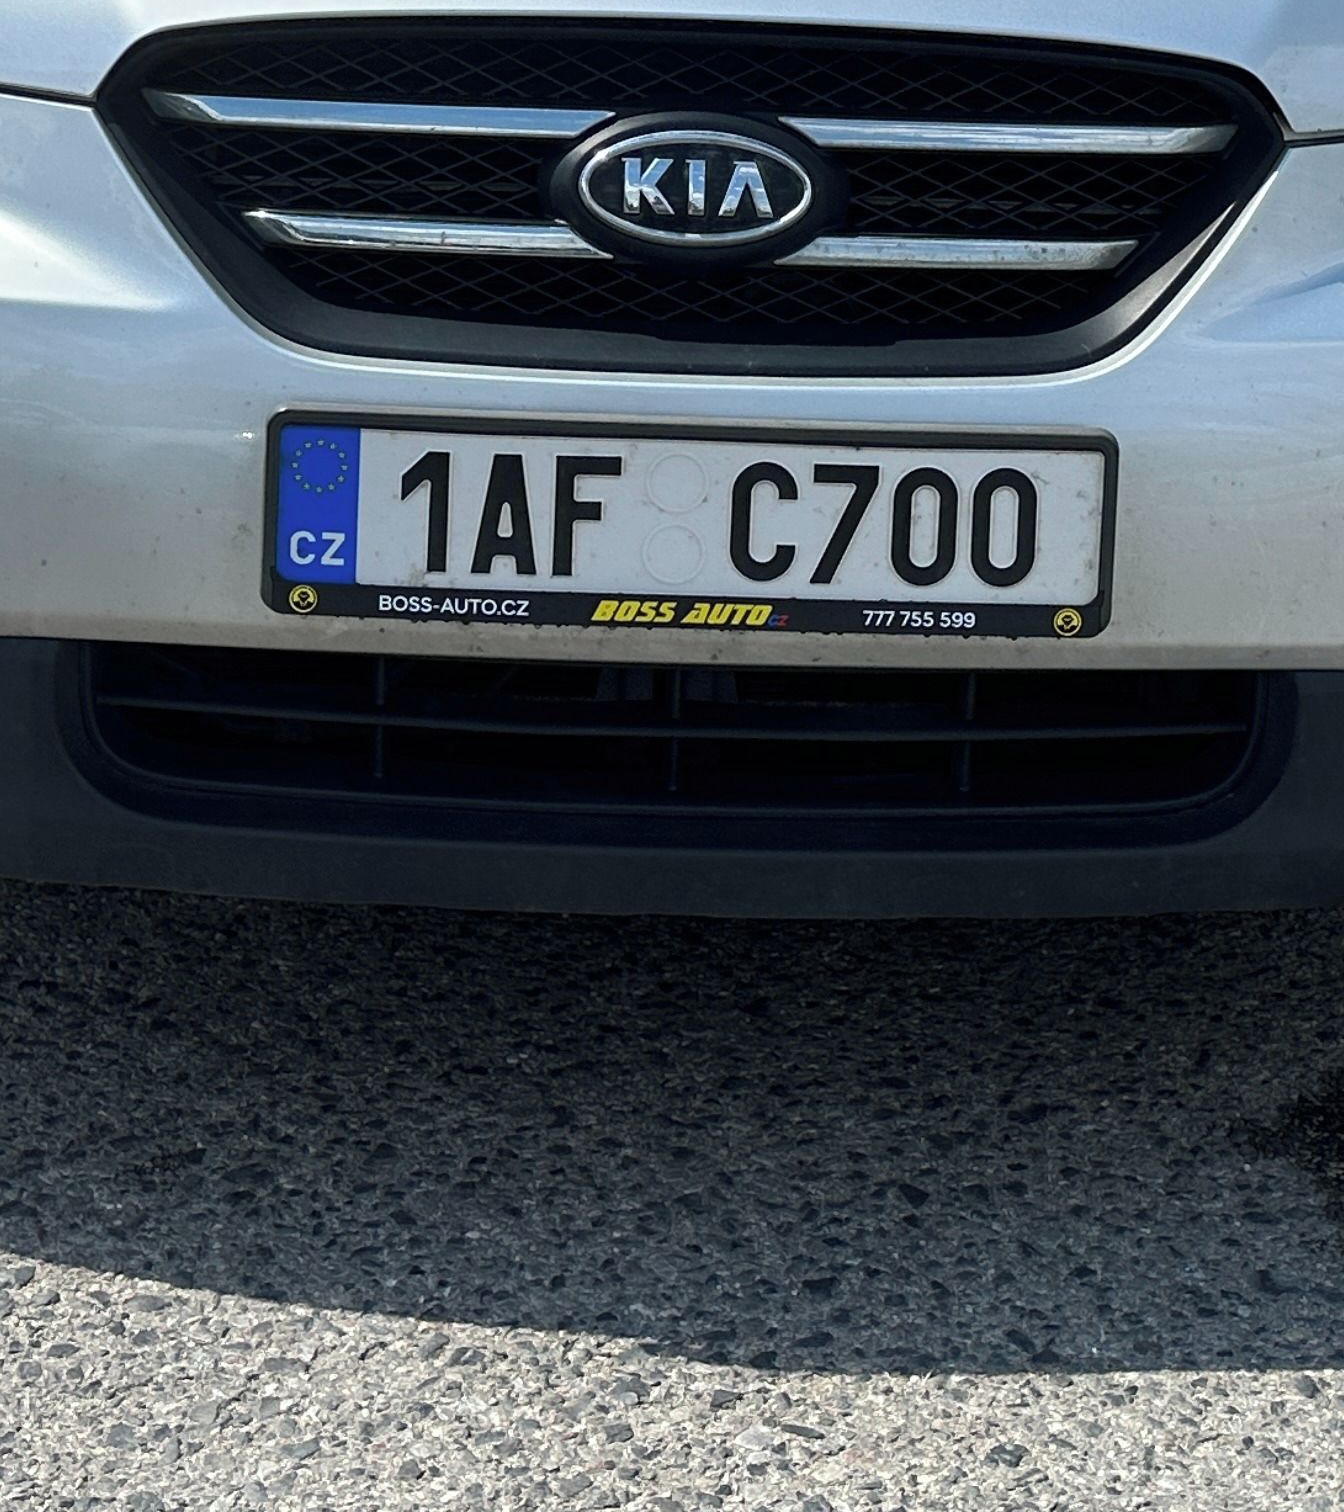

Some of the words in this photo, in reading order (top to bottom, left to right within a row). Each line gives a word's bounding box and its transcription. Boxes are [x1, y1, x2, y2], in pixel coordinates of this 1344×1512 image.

[621, 157, 774, 218] KIA
[399, 450, 623, 577] 1AF
[728, 461, 1038, 587] C700
[289, 530, 346, 566] CZ
[378, 594, 531, 617] BOSS-AUTO.CZ
[591, 599, 677, 623] BOSS
[680, 602, 773, 626] AUTO
[862, 609, 896, 627] 777
[899, 610, 935, 628] 755
[939, 611, 976, 629] 599
